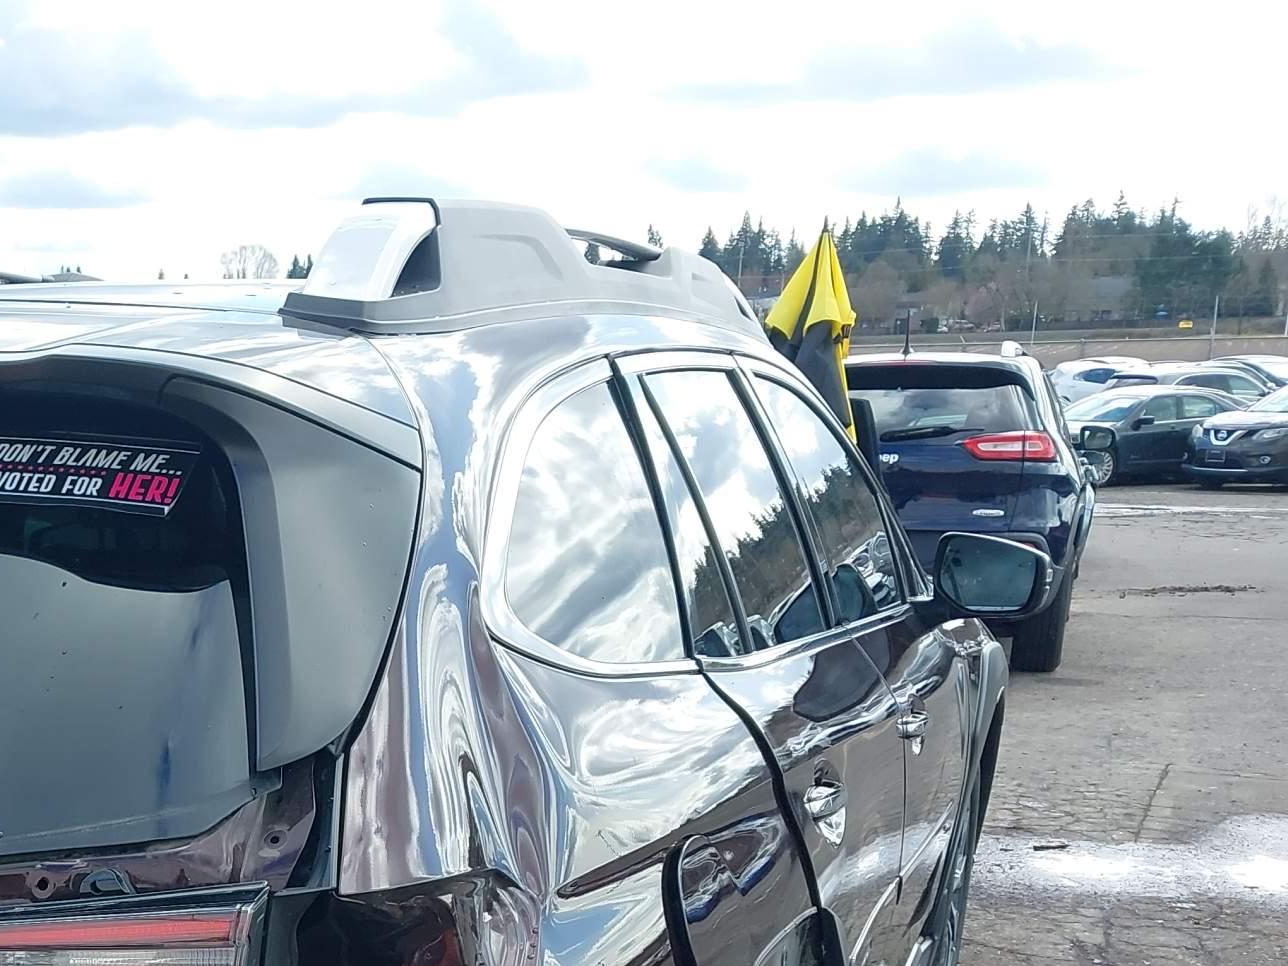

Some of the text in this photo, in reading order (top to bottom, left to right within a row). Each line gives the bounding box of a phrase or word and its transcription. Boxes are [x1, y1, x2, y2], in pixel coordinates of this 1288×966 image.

[53, 447, 131, 470] BLAME
[129, 453, 183, 476] ME...
[879, 453, 899, 465] ep
[60, 475, 103, 497] FOR
[108, 471, 182, 504] HER!
